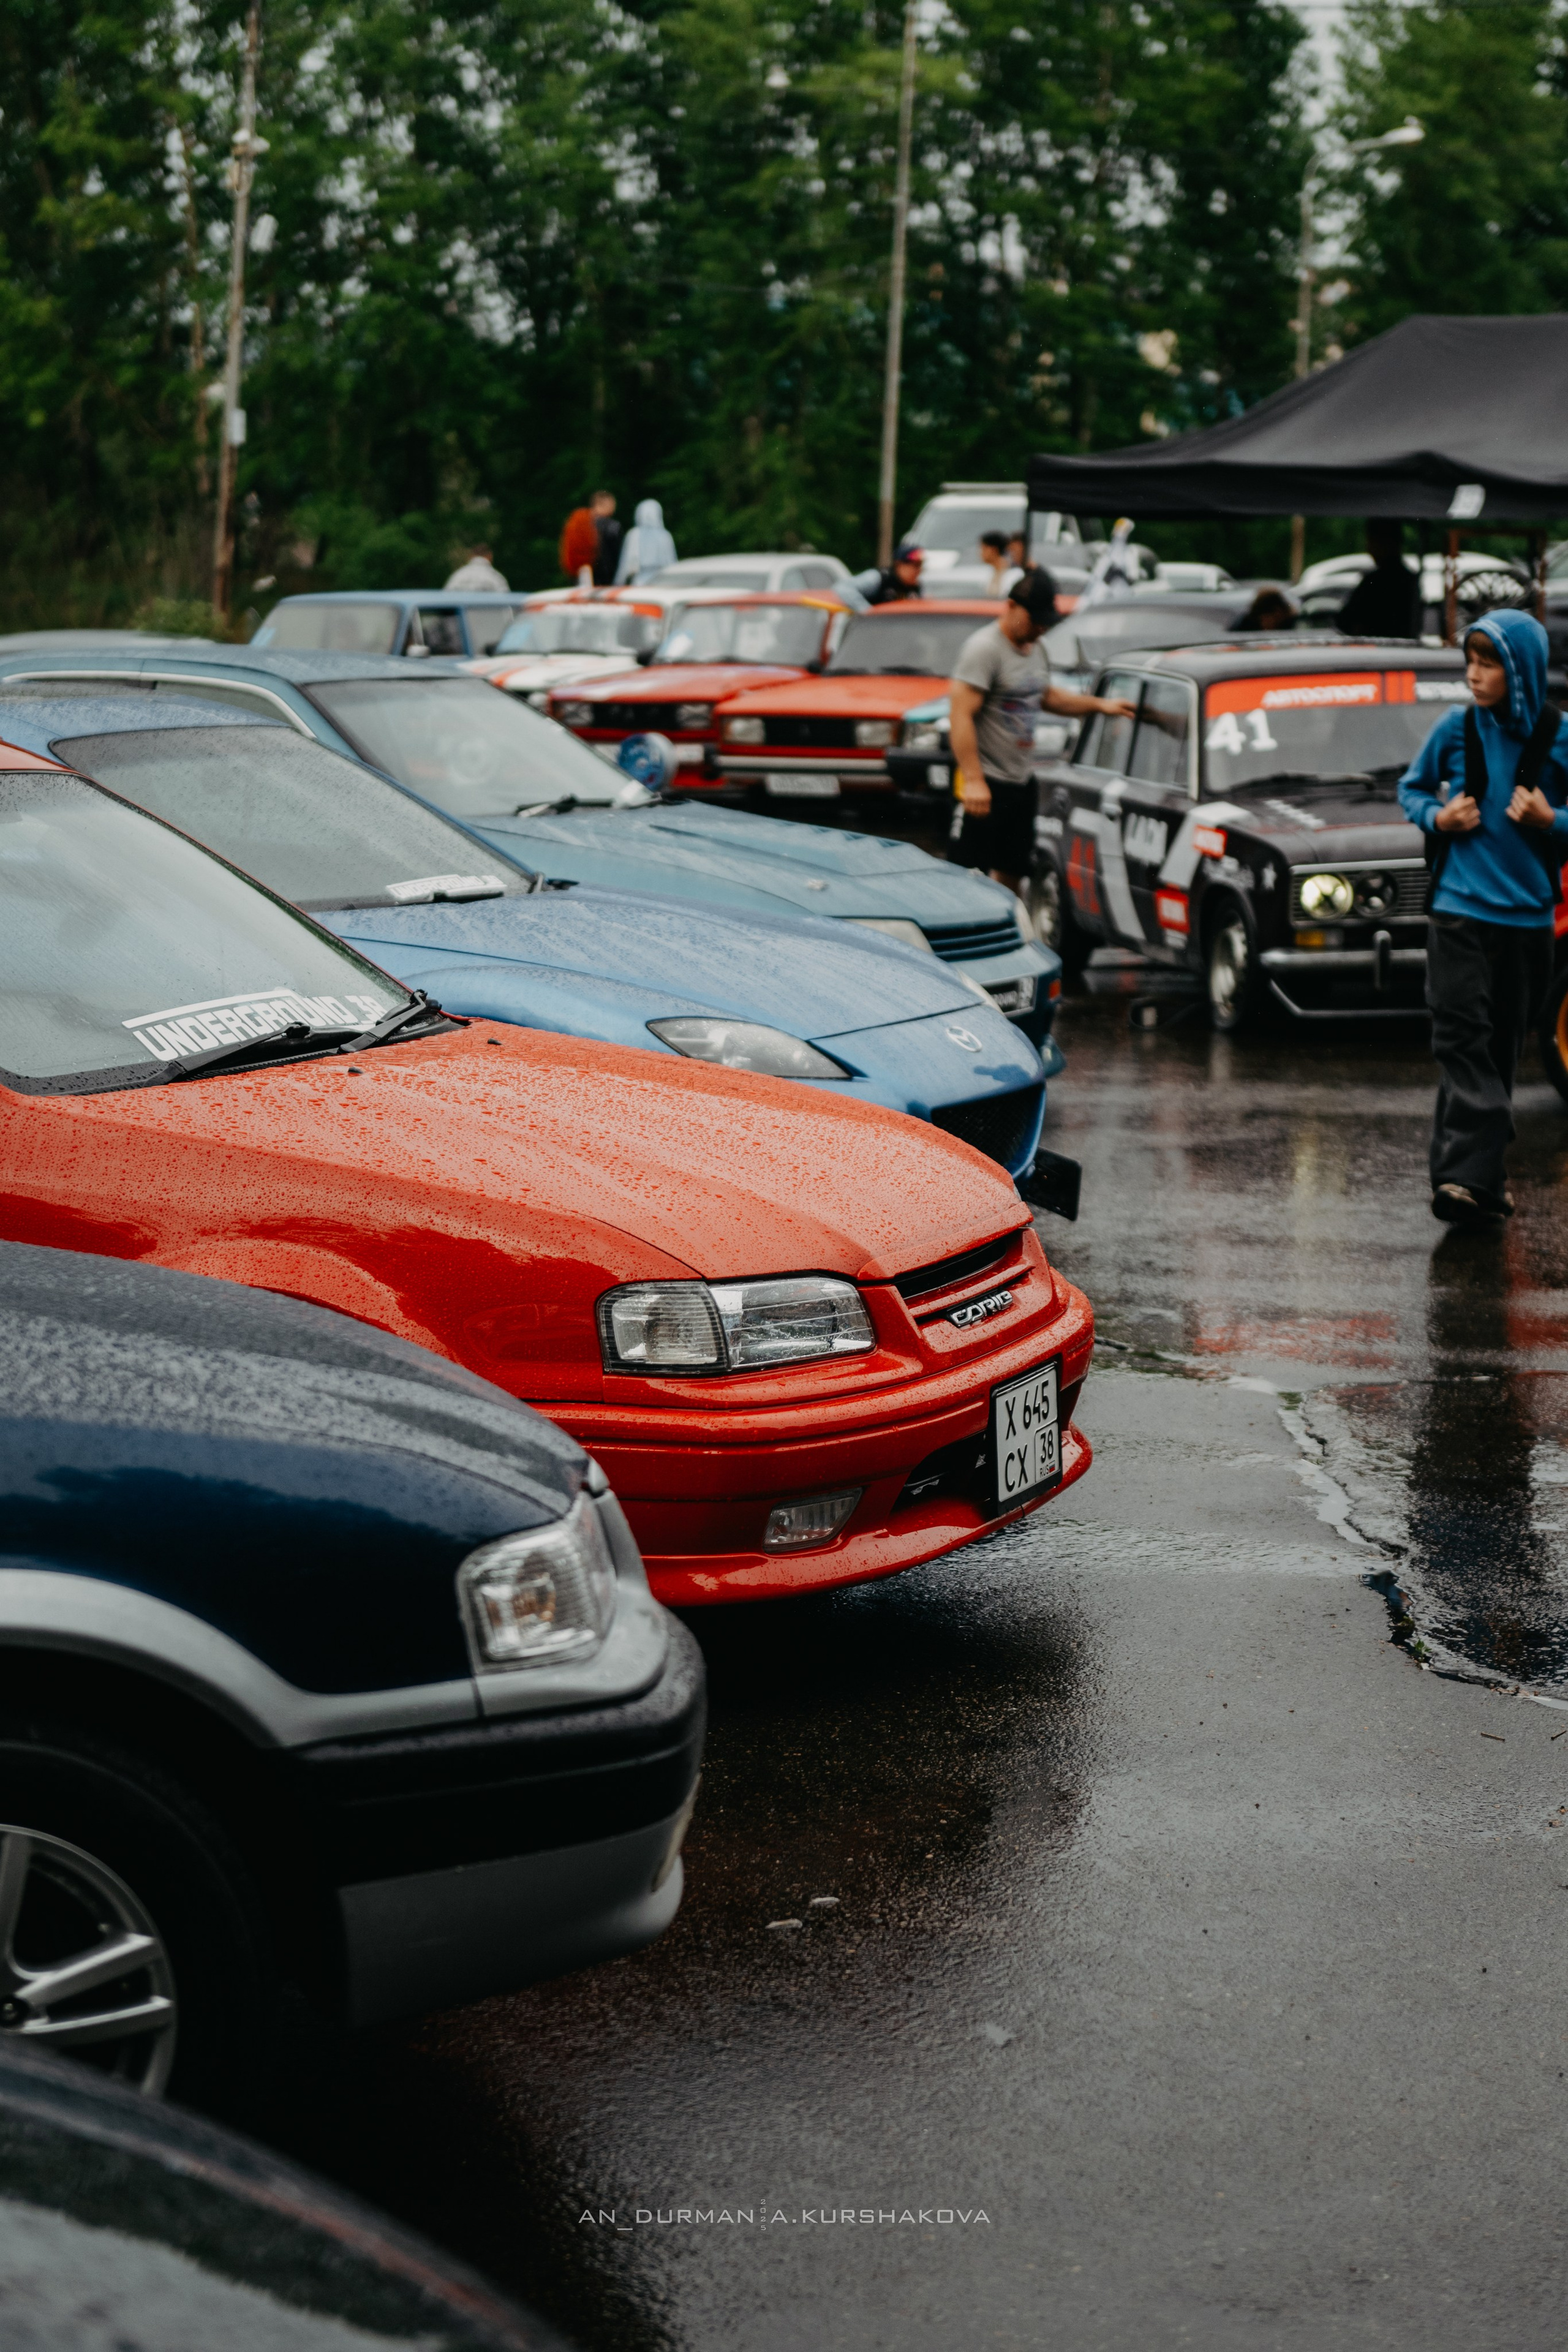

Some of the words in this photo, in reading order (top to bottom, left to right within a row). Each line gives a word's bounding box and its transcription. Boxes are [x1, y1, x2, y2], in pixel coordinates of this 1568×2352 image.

[1204, 708, 1278, 755] 41
[132, 993, 358, 1061] UNDERGROUND
[1023, 1379, 1050, 1430] 645
[1041, 1429, 1054, 1463] 38
[1039, 1464, 1049, 1479] RUS
